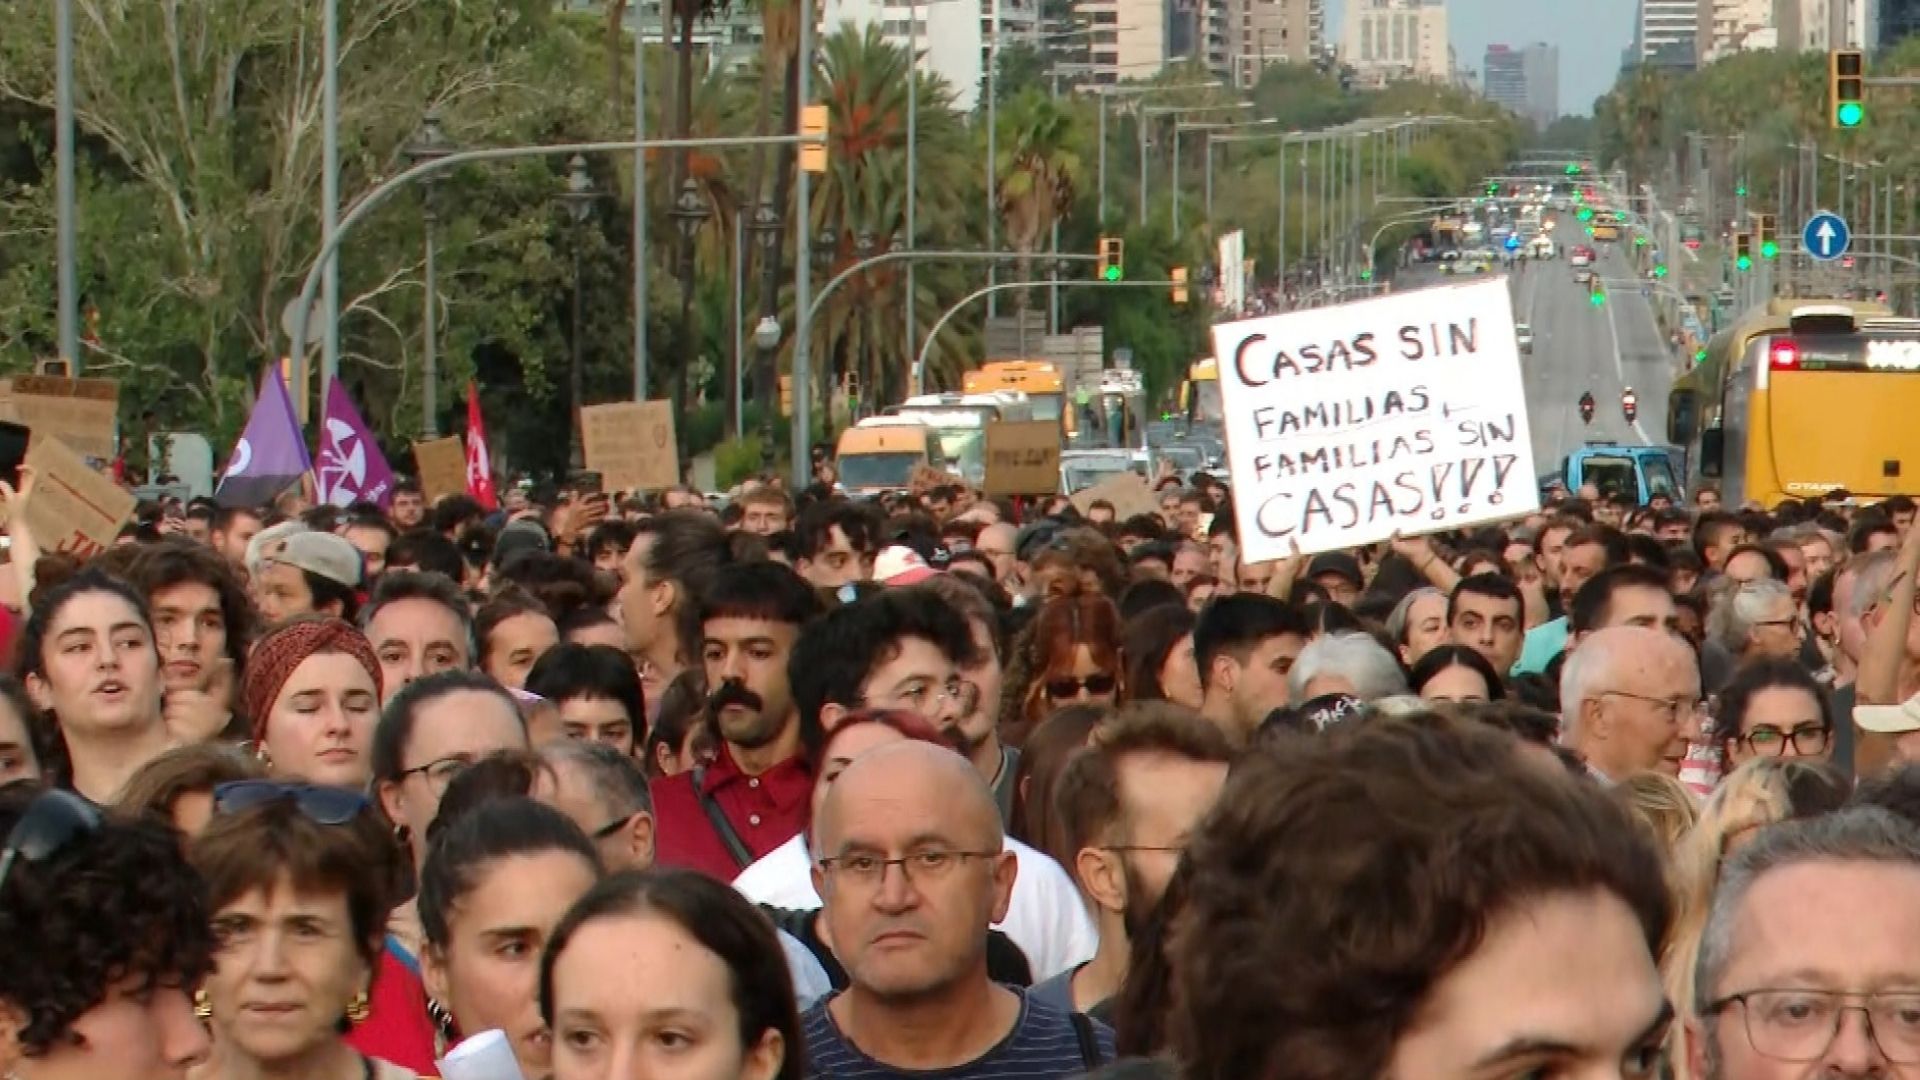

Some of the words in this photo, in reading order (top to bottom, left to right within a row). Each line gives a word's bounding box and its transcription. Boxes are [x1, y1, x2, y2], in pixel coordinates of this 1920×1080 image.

[1234, 332, 1378, 387] CASAS
[1399, 318, 1478, 361] SIN
[1254, 429, 1434, 482] FAMILIAS
[1457, 413, 1515, 447] SIN
